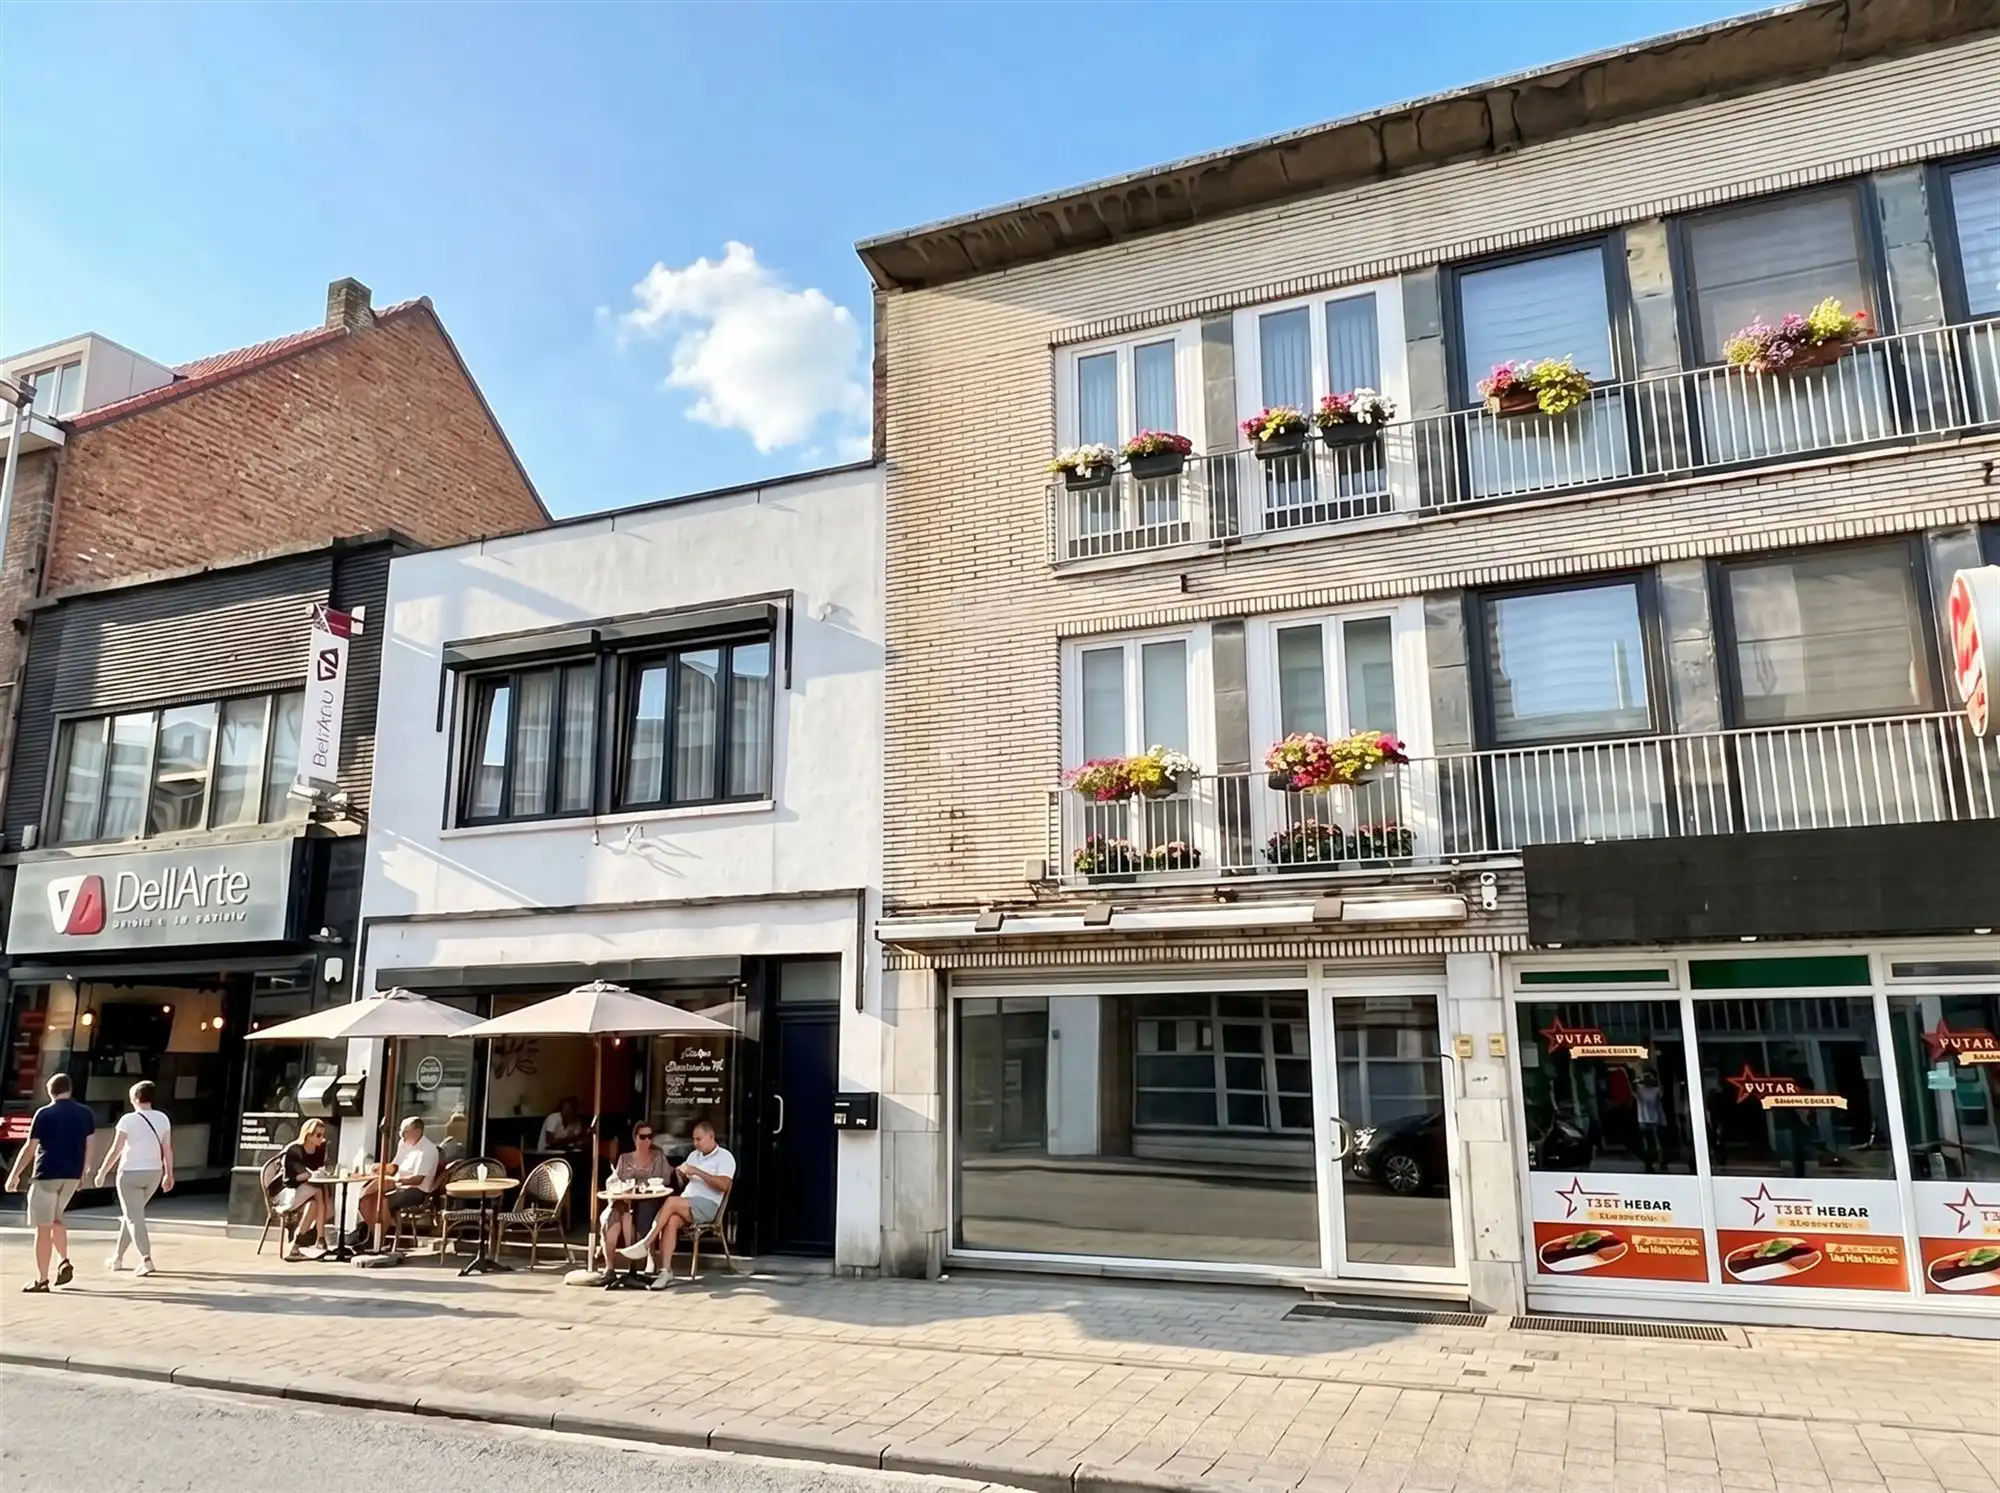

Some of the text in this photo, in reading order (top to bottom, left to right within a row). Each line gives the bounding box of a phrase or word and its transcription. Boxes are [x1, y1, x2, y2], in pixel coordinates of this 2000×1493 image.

[112, 864, 250, 914] DellArte
[1623, 1199, 1672, 1212] HEBAR
[1817, 1205, 1869, 1218] HEBAR
